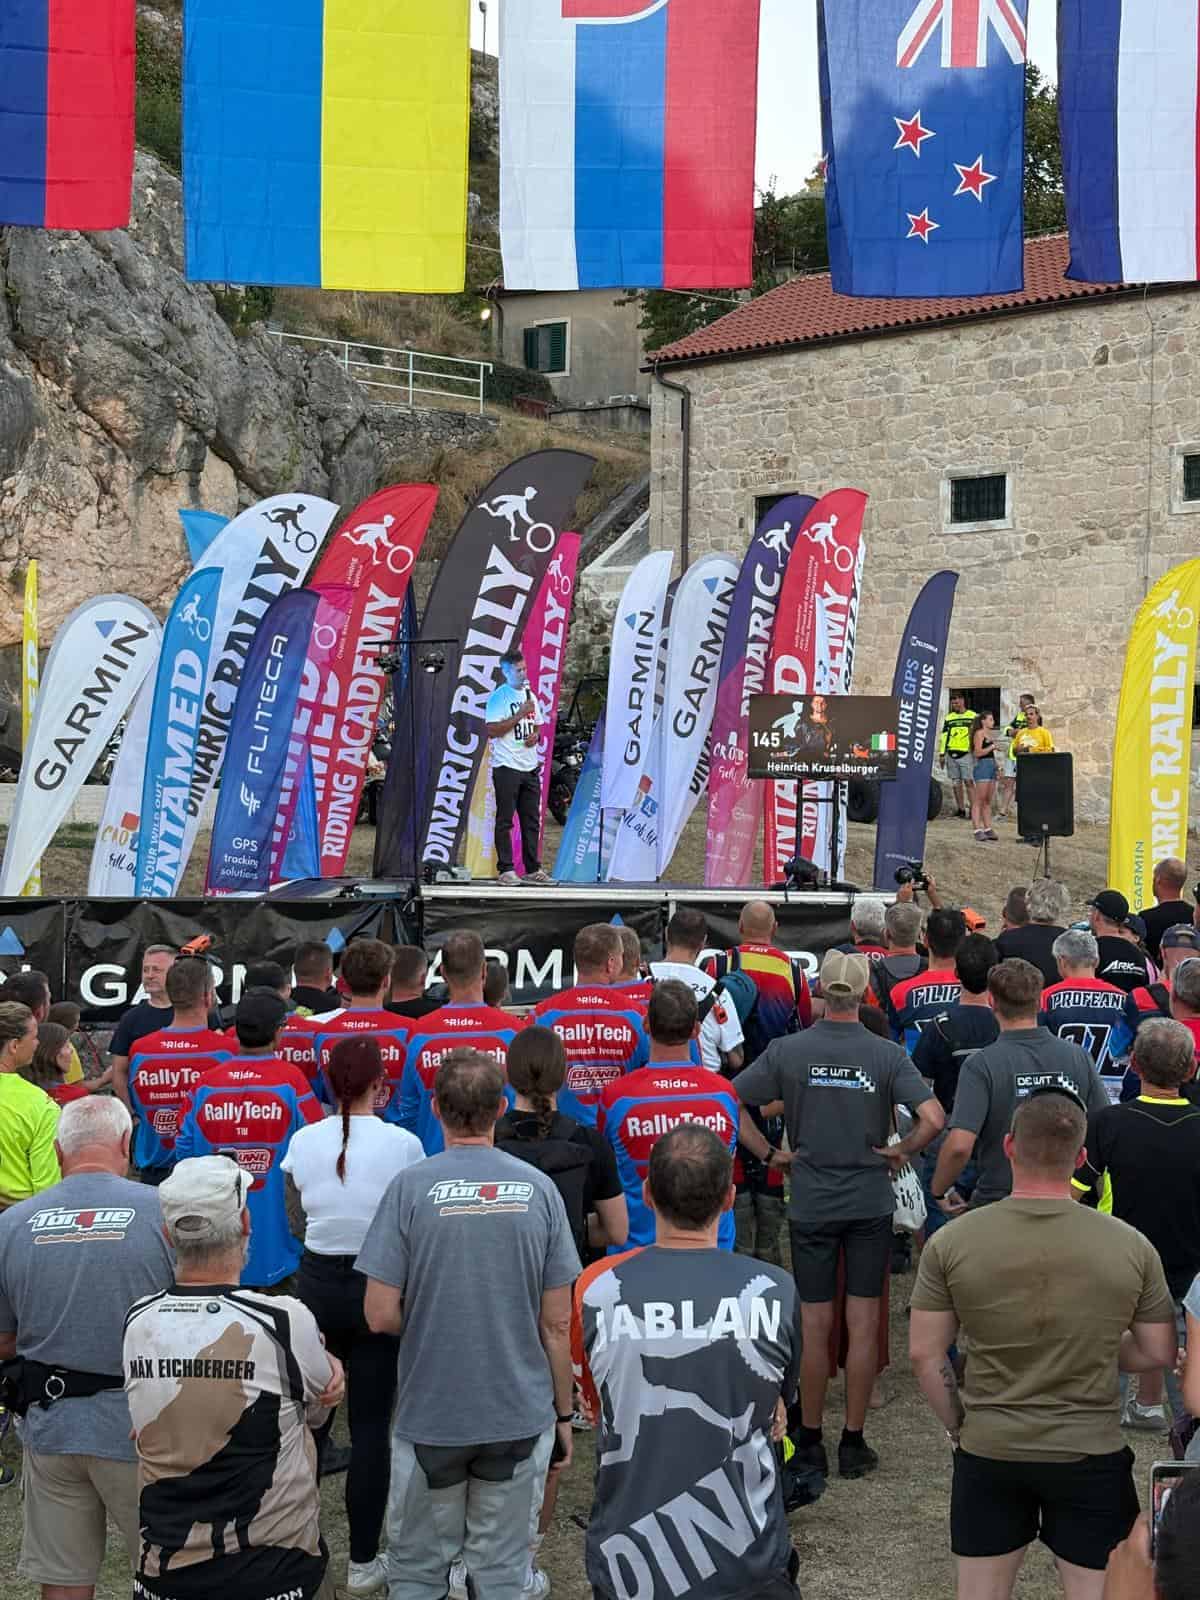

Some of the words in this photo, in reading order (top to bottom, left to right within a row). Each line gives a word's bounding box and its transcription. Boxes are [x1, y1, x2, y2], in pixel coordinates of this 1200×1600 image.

[451, 544, 533, 723] RALLY
[538, 588, 567, 725] RALLY
[673, 577, 738, 738] GARMIN
[337, 582, 400, 768] ACADEMY
[624, 611, 655, 765] GARMIN
[903, 658, 919, 695] GPS
[34, 620, 151, 791] GARMIN
[248, 634, 289, 774] FLITECA
[914, 664, 934, 762] SOLUTIONS
[1150, 631, 1191, 777] RALLY
[752, 731, 780, 748] 145
[152, 649, 203, 897] UNTAMED
[423, 723, 480, 862] DINARIC
[767, 761, 809, 774] Heinrich
[812, 763, 879, 776] Kruselburger
[150, 816, 161, 845] WILD
[322, 772, 357, 857] RIDING
[575, 833, 589, 865] RIDE
[584, 800, 600, 834] YOUR
[145, 850, 158, 877] YOUR
[232, 837, 258, 852] GPS
[1135, 841, 1145, 910] GARMIN
[554, 1024, 632, 1044] RallyTech
[138, 1068, 202, 1088] RallyTe
[811, 1066, 828, 1077] DE
[830, 1068, 851, 1078] WIT
[1017, 1076, 1033, 1086] DE
[1033, 1075, 1053, 1086] WIT
[204, 1102, 283, 1124] RallyTech
[433, 1182, 531, 1202] Torque
[33, 1209, 133, 1230] Torque
[595, 1296, 781, 1347] JABLAN
[158, 1358, 256, 1381] EICHBERGER
